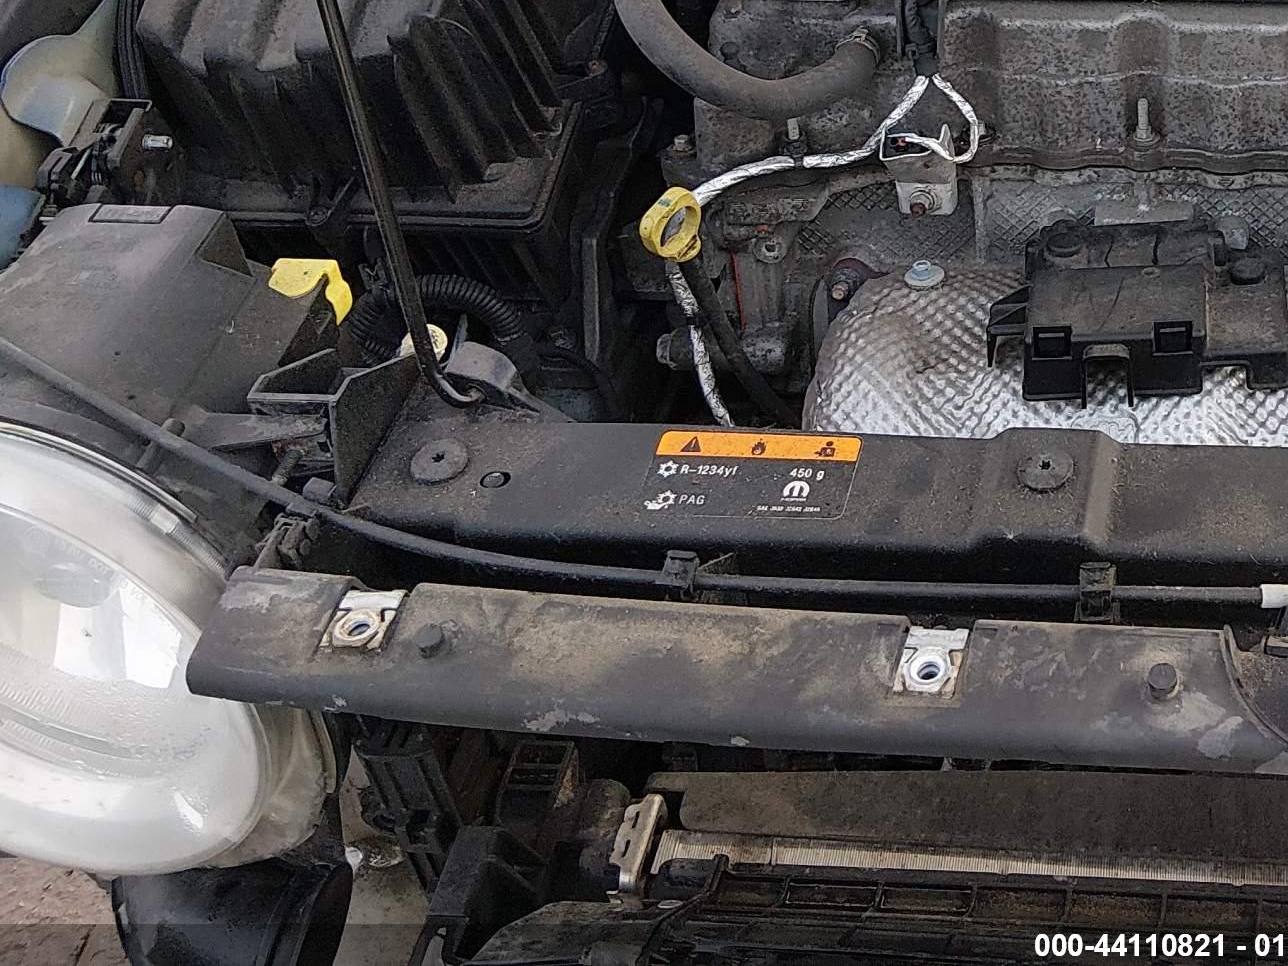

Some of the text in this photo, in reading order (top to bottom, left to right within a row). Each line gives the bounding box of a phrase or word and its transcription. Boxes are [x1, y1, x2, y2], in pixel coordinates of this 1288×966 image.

[680, 464, 825, 481] R-1234yf 450 g
[678, 494, 706, 505] PAG
